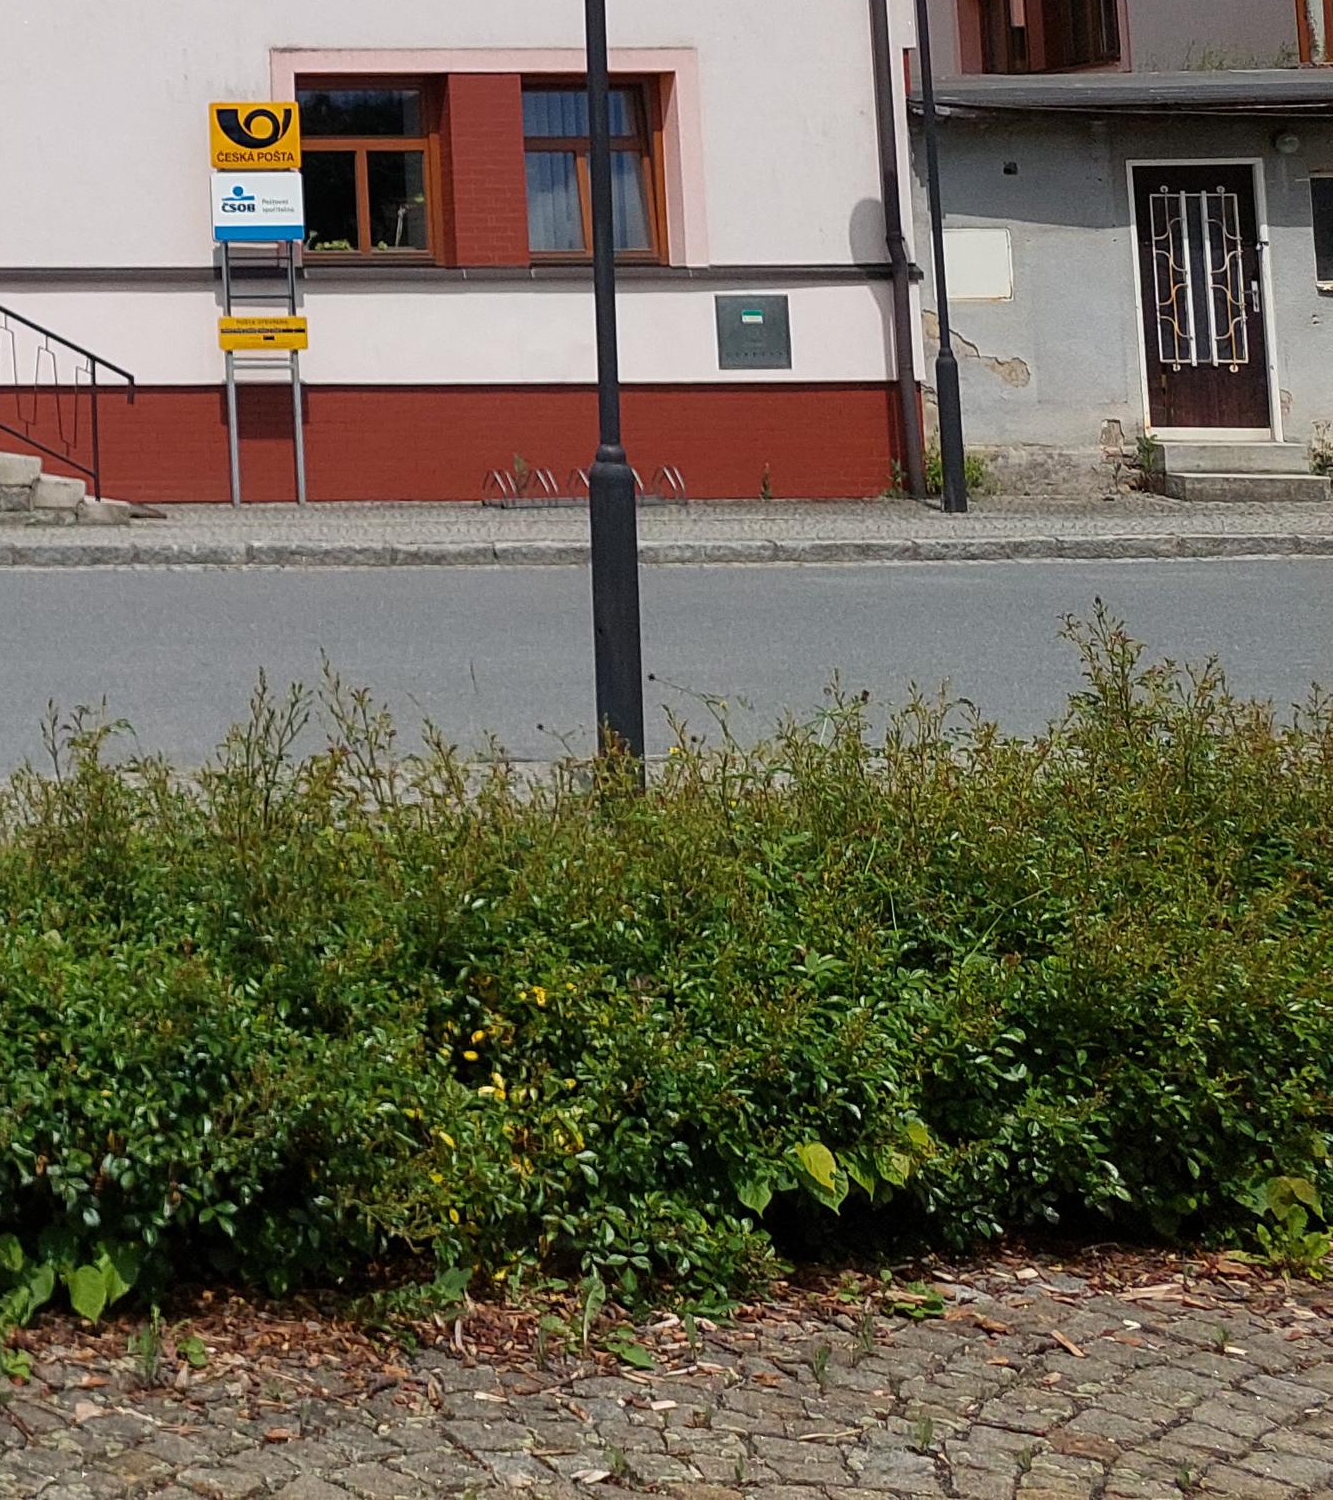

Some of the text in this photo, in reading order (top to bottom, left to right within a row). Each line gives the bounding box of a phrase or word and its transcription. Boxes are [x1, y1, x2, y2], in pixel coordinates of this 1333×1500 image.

[216, 150, 295, 162] ČESKÁ POŠTA
[221, 202, 256, 213] ČSOB
